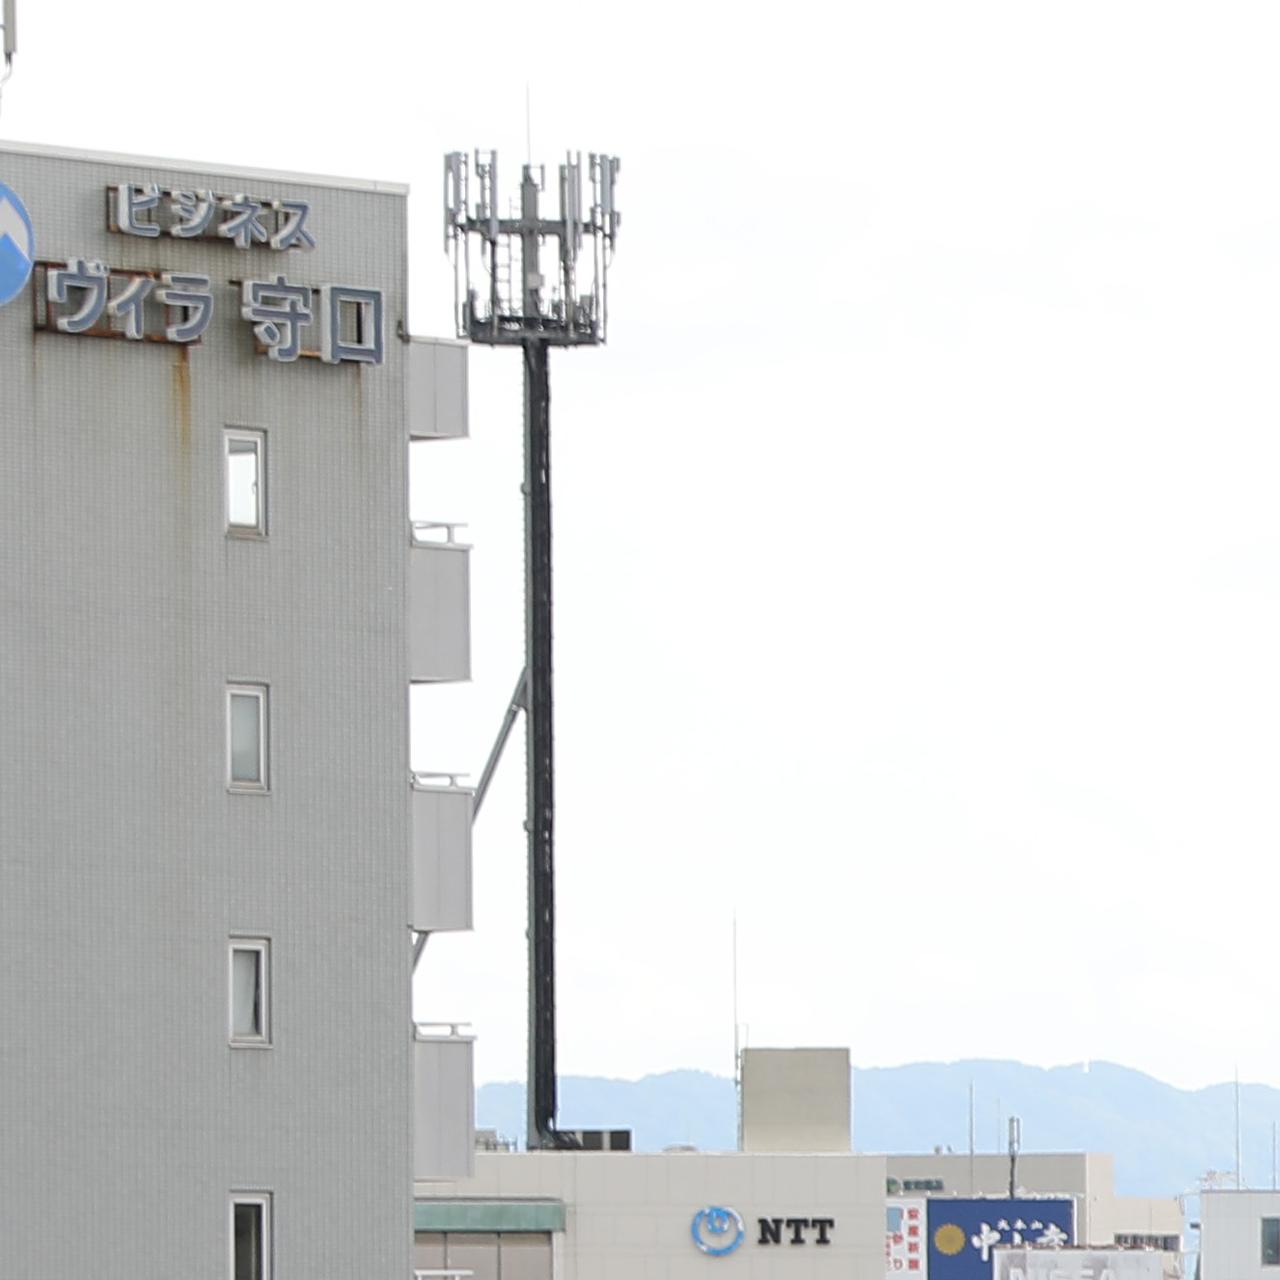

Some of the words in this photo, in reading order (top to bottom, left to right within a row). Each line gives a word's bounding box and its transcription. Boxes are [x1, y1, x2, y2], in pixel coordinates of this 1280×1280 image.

[117, 182, 316, 250] ビジネス
[47, 257, 214, 342] ヴィラ
[241, 274, 385, 365] 守口
[757, 1218, 835, 1246] NTT
[971, 1222, 1068, 1262] 中寺
